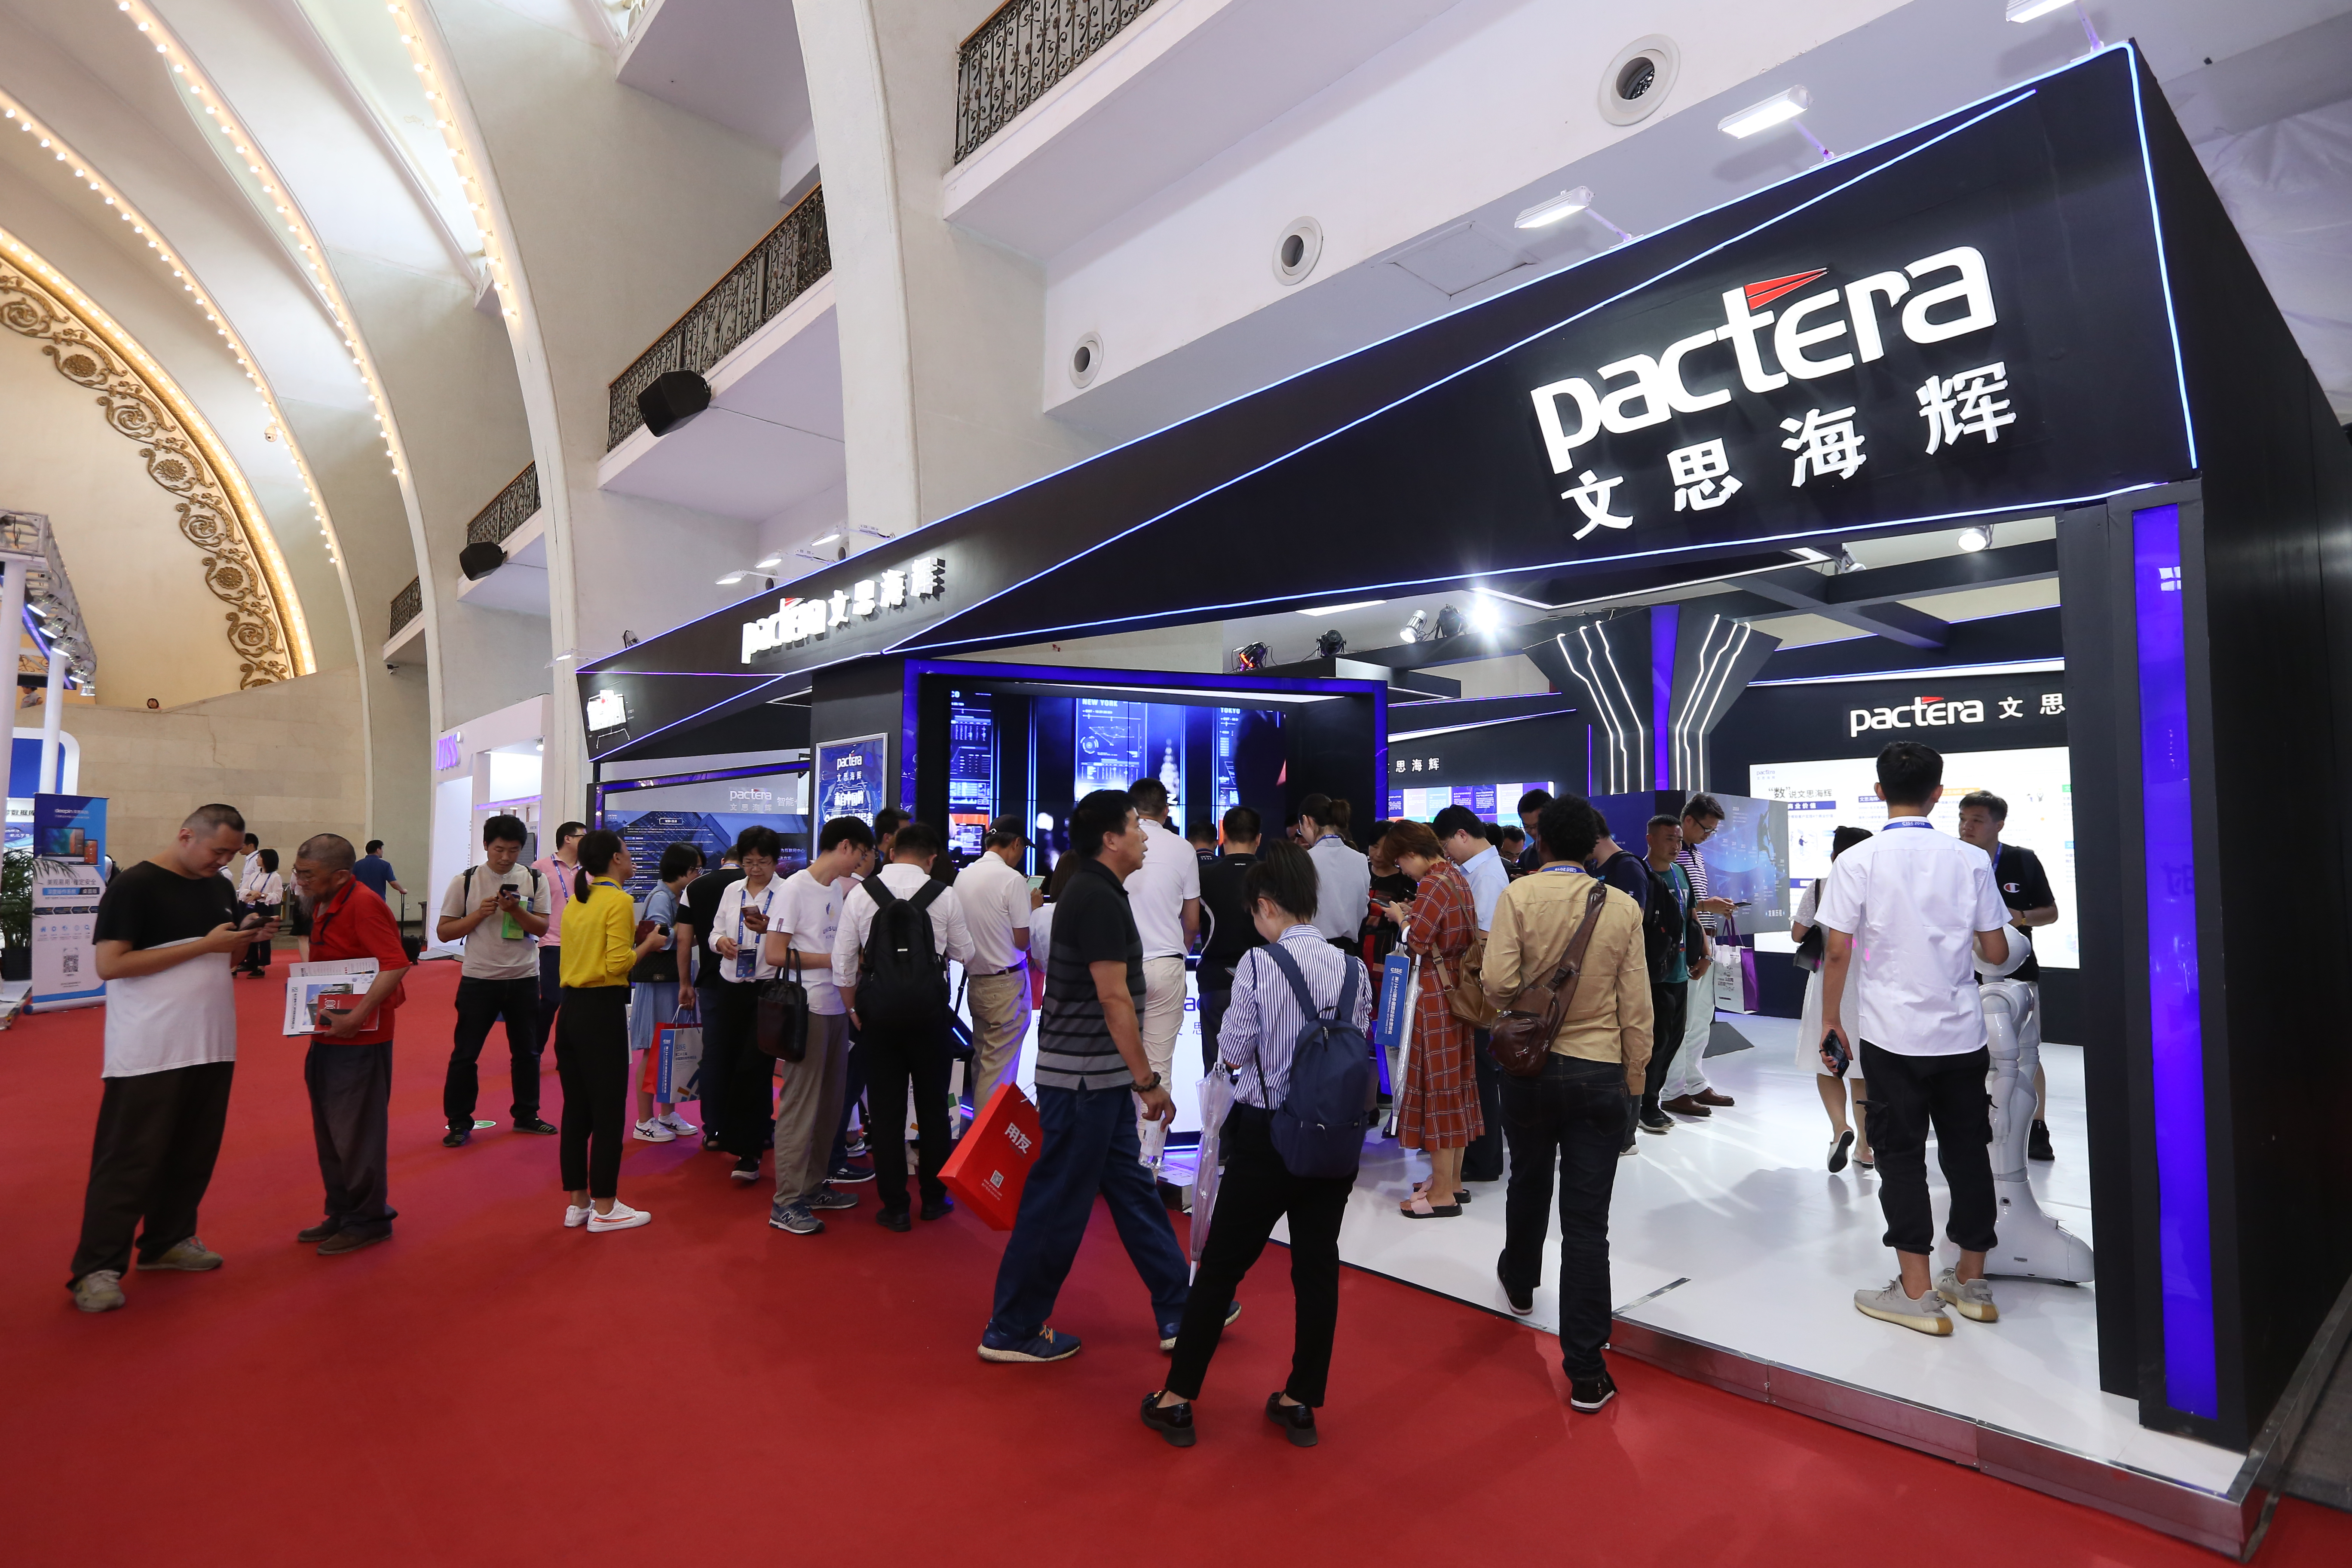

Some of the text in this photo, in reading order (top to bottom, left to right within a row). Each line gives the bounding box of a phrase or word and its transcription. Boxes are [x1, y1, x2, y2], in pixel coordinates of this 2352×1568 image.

[1531, 246, 1998, 475] pactera
[1561, 361, 2016, 540] 文思海辉
[741, 557, 942, 664] pactera 文思海辉
[1850, 696, 1984, 737] pactera
[837, 752, 862, 771] pactera
[1388, 757, 1440, 773] 思海辉
[836, 771, 862, 782] 文思海辉
[730, 789, 772, 801] pactera
[834, 790, 864, 806] 来自中国的
[730, 803, 772, 812] 文思海辉
[1004, 1122, 1032, 1154] 用友
